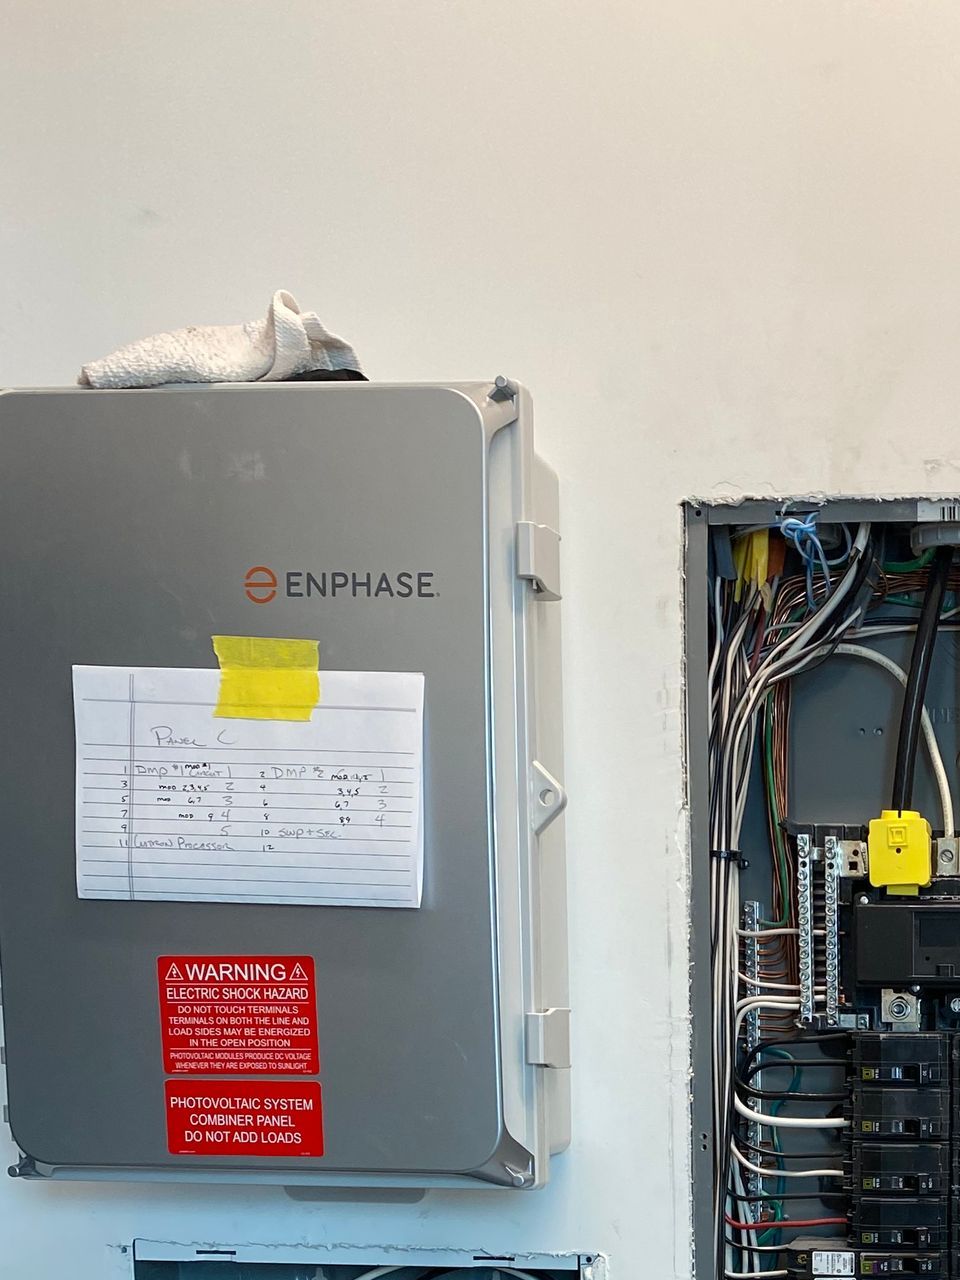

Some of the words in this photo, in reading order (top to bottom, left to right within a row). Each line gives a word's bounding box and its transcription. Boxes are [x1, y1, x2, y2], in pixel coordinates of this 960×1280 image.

[286, 571, 435, 598] ENPHASE
[217, 729, 237, 745] C
[271, 767, 306, 778] DMP
[120, 780, 128, 788] 3
[225, 782, 234, 791] 2
[378, 785, 389, 794] 2
[222, 796, 233, 805] 3
[378, 800, 387, 810] 3
[120, 809, 128, 817] 7
[221, 809, 231, 821] 4
[375, 814, 385, 826] 4
[121, 824, 128, 832] 9
[220, 825, 231, 836] 5
[119, 838, 128, 847] 11
[263, 844, 274, 852] 12
[185, 964, 286, 980] WARNING
[167, 988, 219, 999] ELECTRIC
[223, 988, 260, 999] SHOCK
[264, 988, 308, 1000] HAZARD
[214, 1006, 246, 1014] TOUCH
[247, 1006, 298, 1014] TERMINALS
[254, 1017, 270, 1025] THE
[194, 1028, 221, 1036] SIDES
[224, 1028, 242, 1036] MAY
[244, 1028, 256, 1036] BE
[259, 1028, 310, 1036] ENERGIZED
[189, 1039, 198, 1047] IN
[200, 1039, 218, 1047] THE
[220, 1039, 245, 1047] OPEN
[248, 1039, 290, 1047] POSITION
[170, 1052, 214, 1060] PHOTOVOLTAIC
[170, 1097, 261, 1110] PHOTOVOLTAIC
[264, 1098, 313, 1110] SYSTEM
[190, 1114, 254, 1126] COMBINER
[257, 1115, 295, 1127] PANEL
[185, 1131, 203, 1142] DO
[206, 1131, 230, 1142] NOT
[232, 1132, 258, 1143] ADD
[262, 1132, 301, 1144] LOADS
